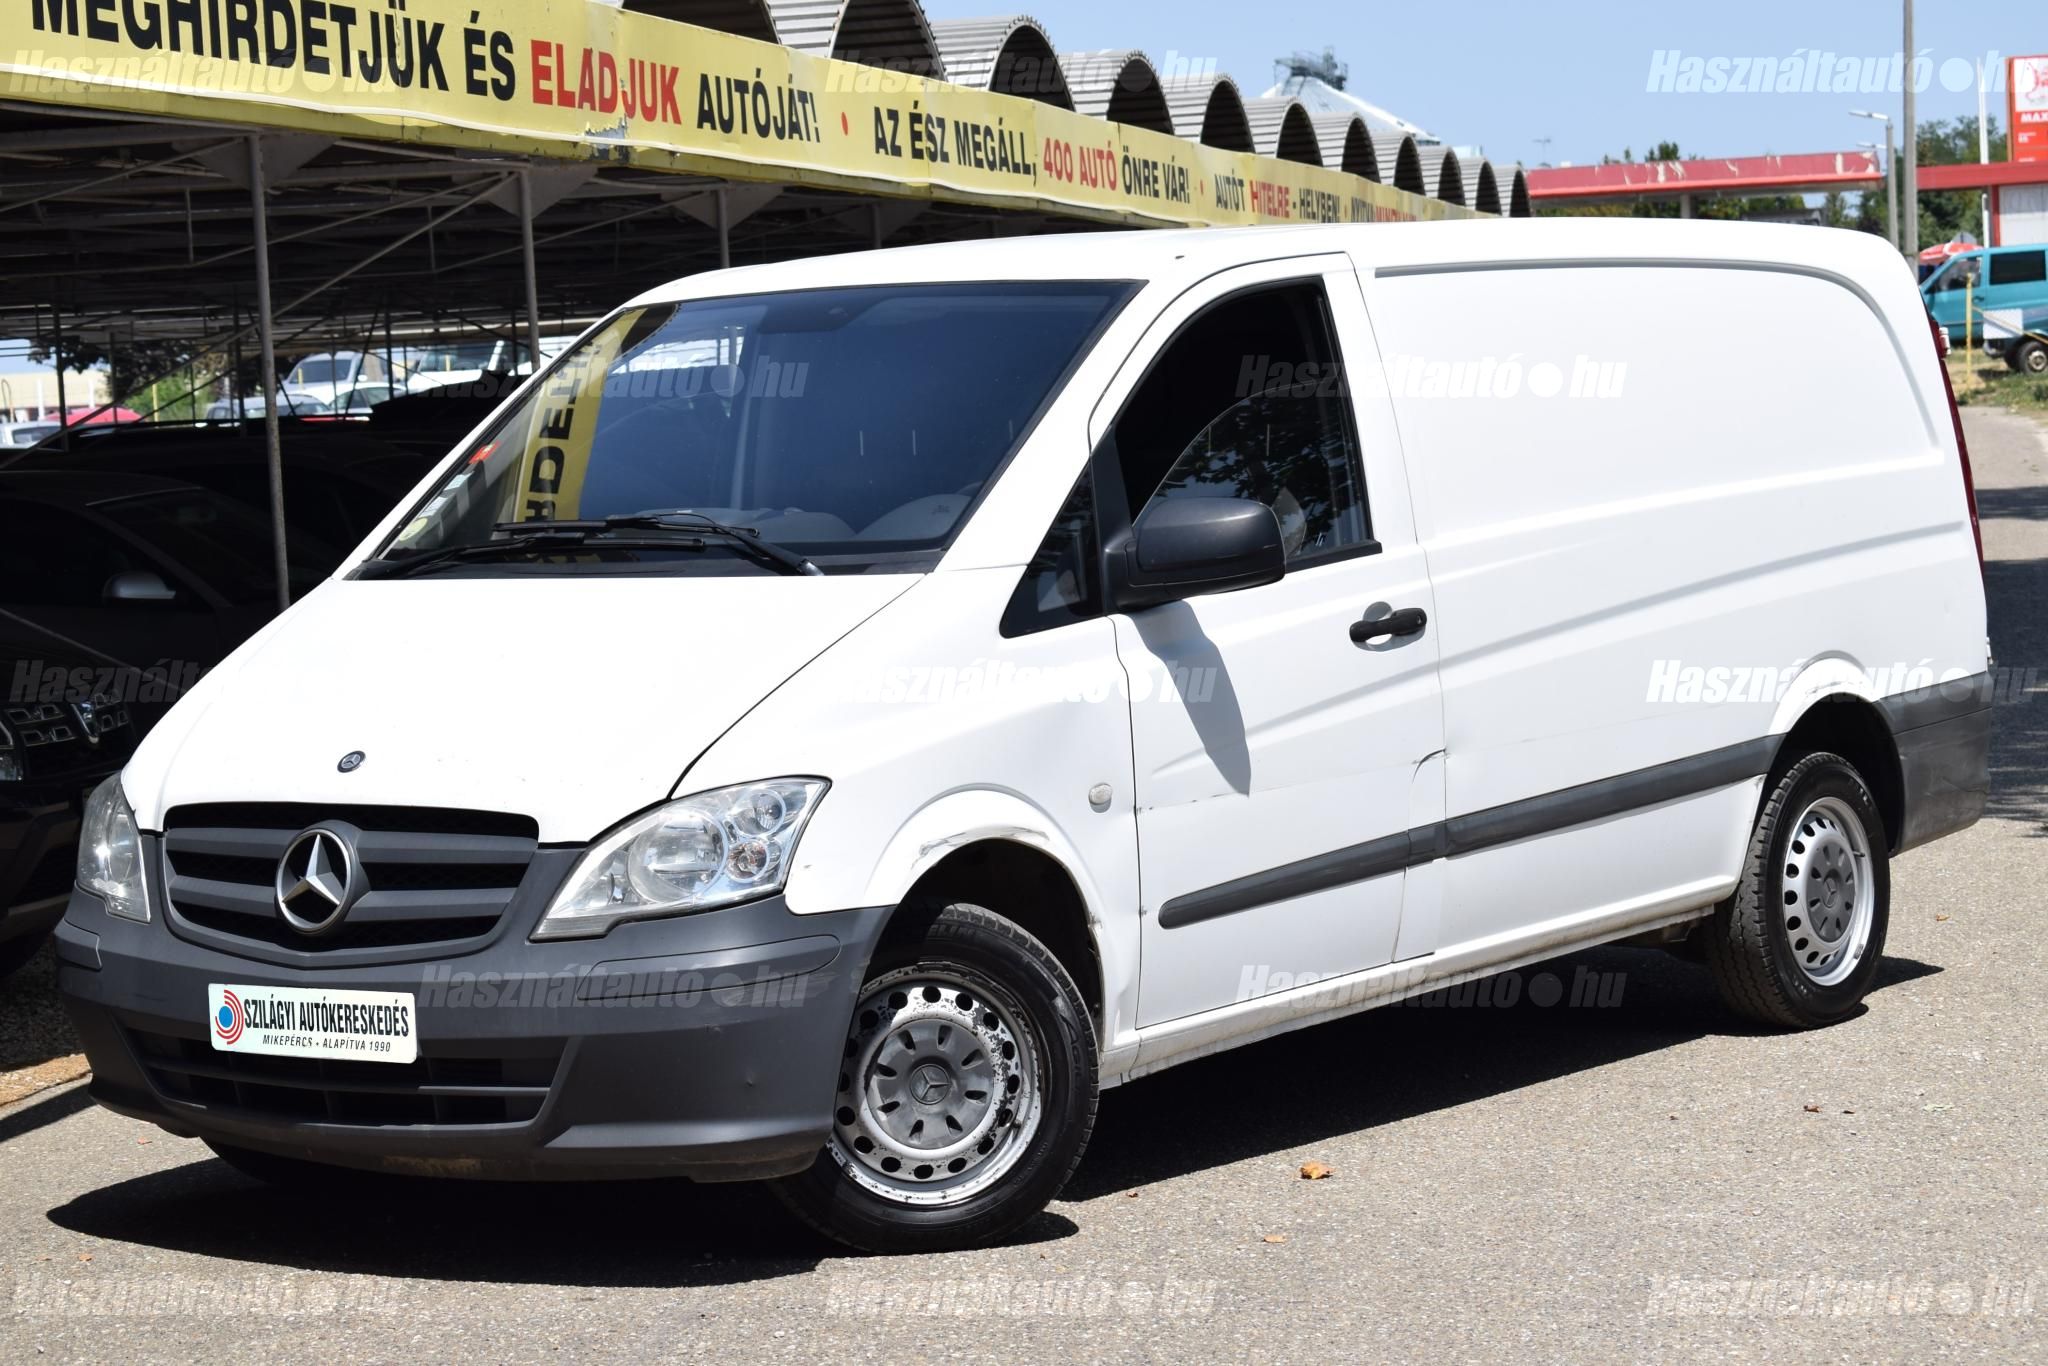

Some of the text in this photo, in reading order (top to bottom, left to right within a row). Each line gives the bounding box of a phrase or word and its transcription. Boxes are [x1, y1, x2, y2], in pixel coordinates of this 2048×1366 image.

[463, 10, 516, 101] ÉS
[530, 39, 682, 125] ELADJUK
[696, 67, 821, 143] AUTÓJÁT!
[873, 105, 901, 157] AZ
[908, 100, 950, 163] ÉSZ
[953, 116, 1038, 187] MEGÁLL,
[1042, 137, 1074, 184] 400
[1078, 140, 1118, 192] AUTÓ
[1121, 146, 1160, 199] ÖNRE
[1162, 155, 1191, 204] VÁR!
[1213, 168, 1246, 212] AUTÓT
[243, 993, 409, 1037] SZILÁGYI AUTÓKERESKEDÉS
[262, 1033, 391, 1053] MIKEPÉRCS ALAPÍTVA 1990
